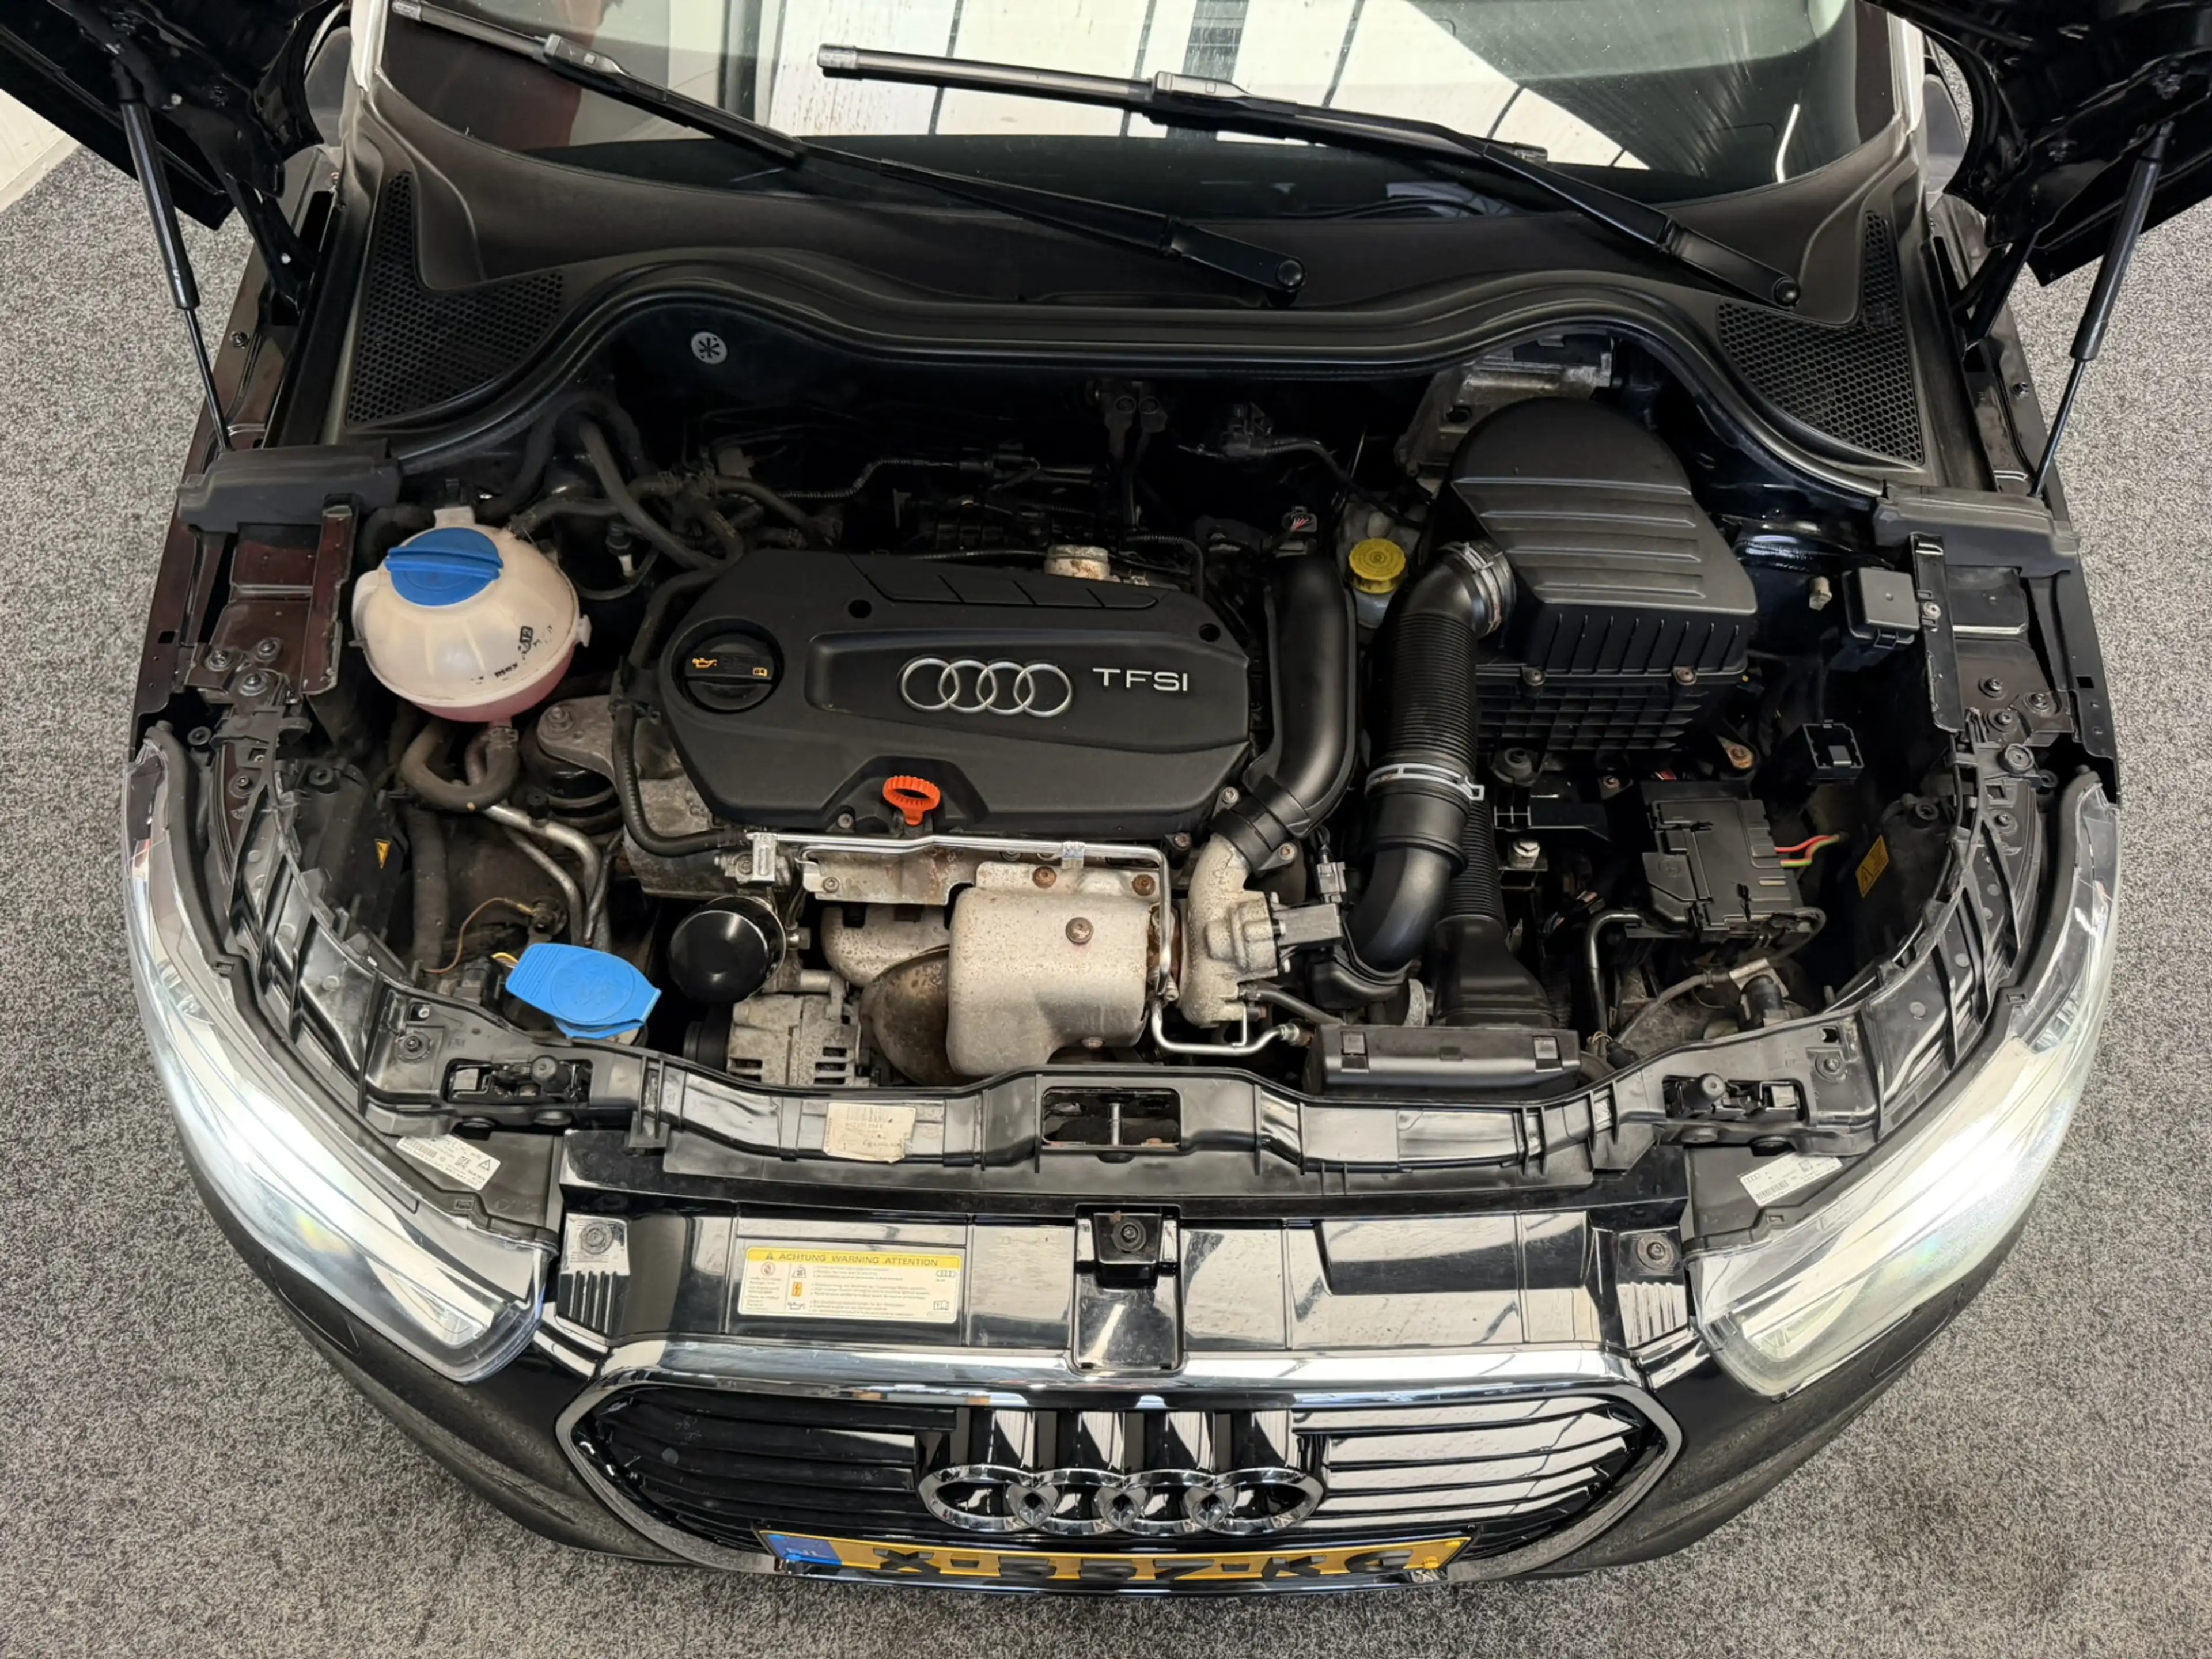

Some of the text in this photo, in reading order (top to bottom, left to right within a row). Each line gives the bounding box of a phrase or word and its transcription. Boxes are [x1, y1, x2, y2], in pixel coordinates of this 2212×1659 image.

[1092, 668, 1188, 691] TFSI
[778, 1252, 938, 1267] ACHTUNG WARNING ATTENTION
